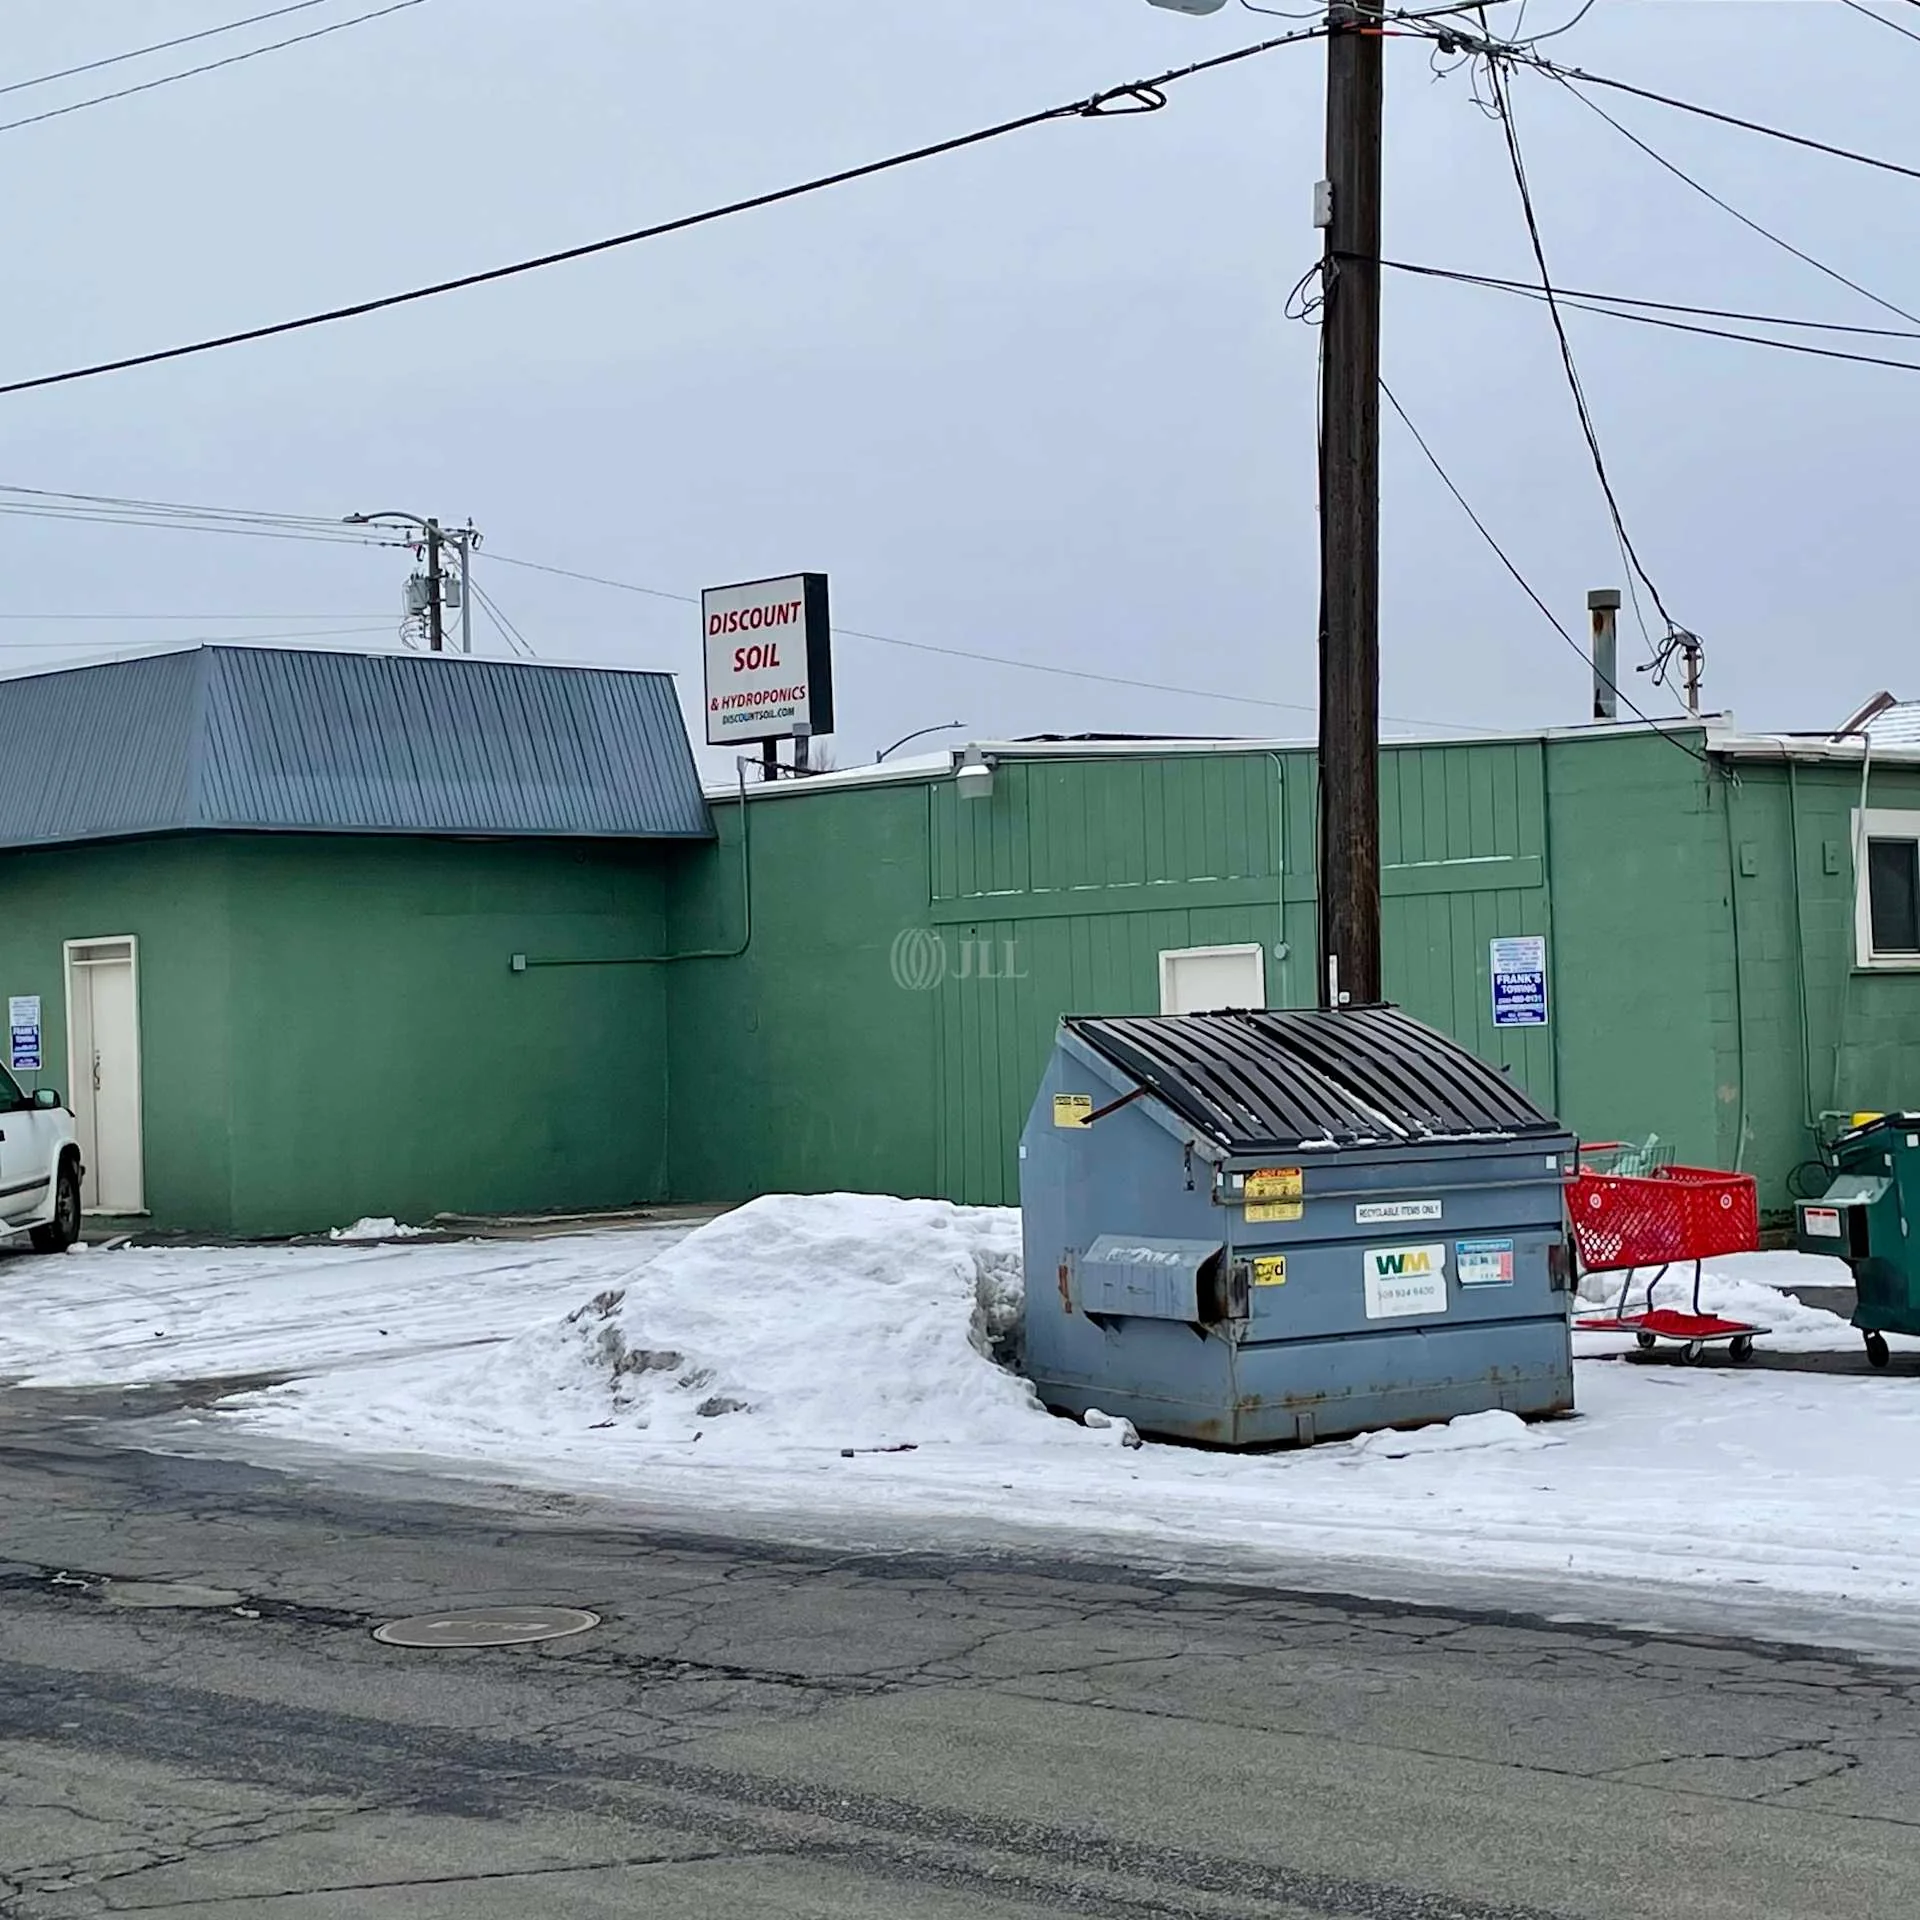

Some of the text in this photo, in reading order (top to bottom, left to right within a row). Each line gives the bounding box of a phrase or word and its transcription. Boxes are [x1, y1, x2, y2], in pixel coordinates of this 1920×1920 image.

[709, 601, 802, 636] DISCOUNT
[733, 643, 780, 673] SOIL
[710, 685, 806, 711] & HYDROPONICS
[722, 707, 795, 725] DISCOUNTSOIL.COM
[1496, 973, 1542, 985] FRANK'S
[1500, 983, 1537, 994] TOWING
[1376, 1252, 1430, 1275] WM
